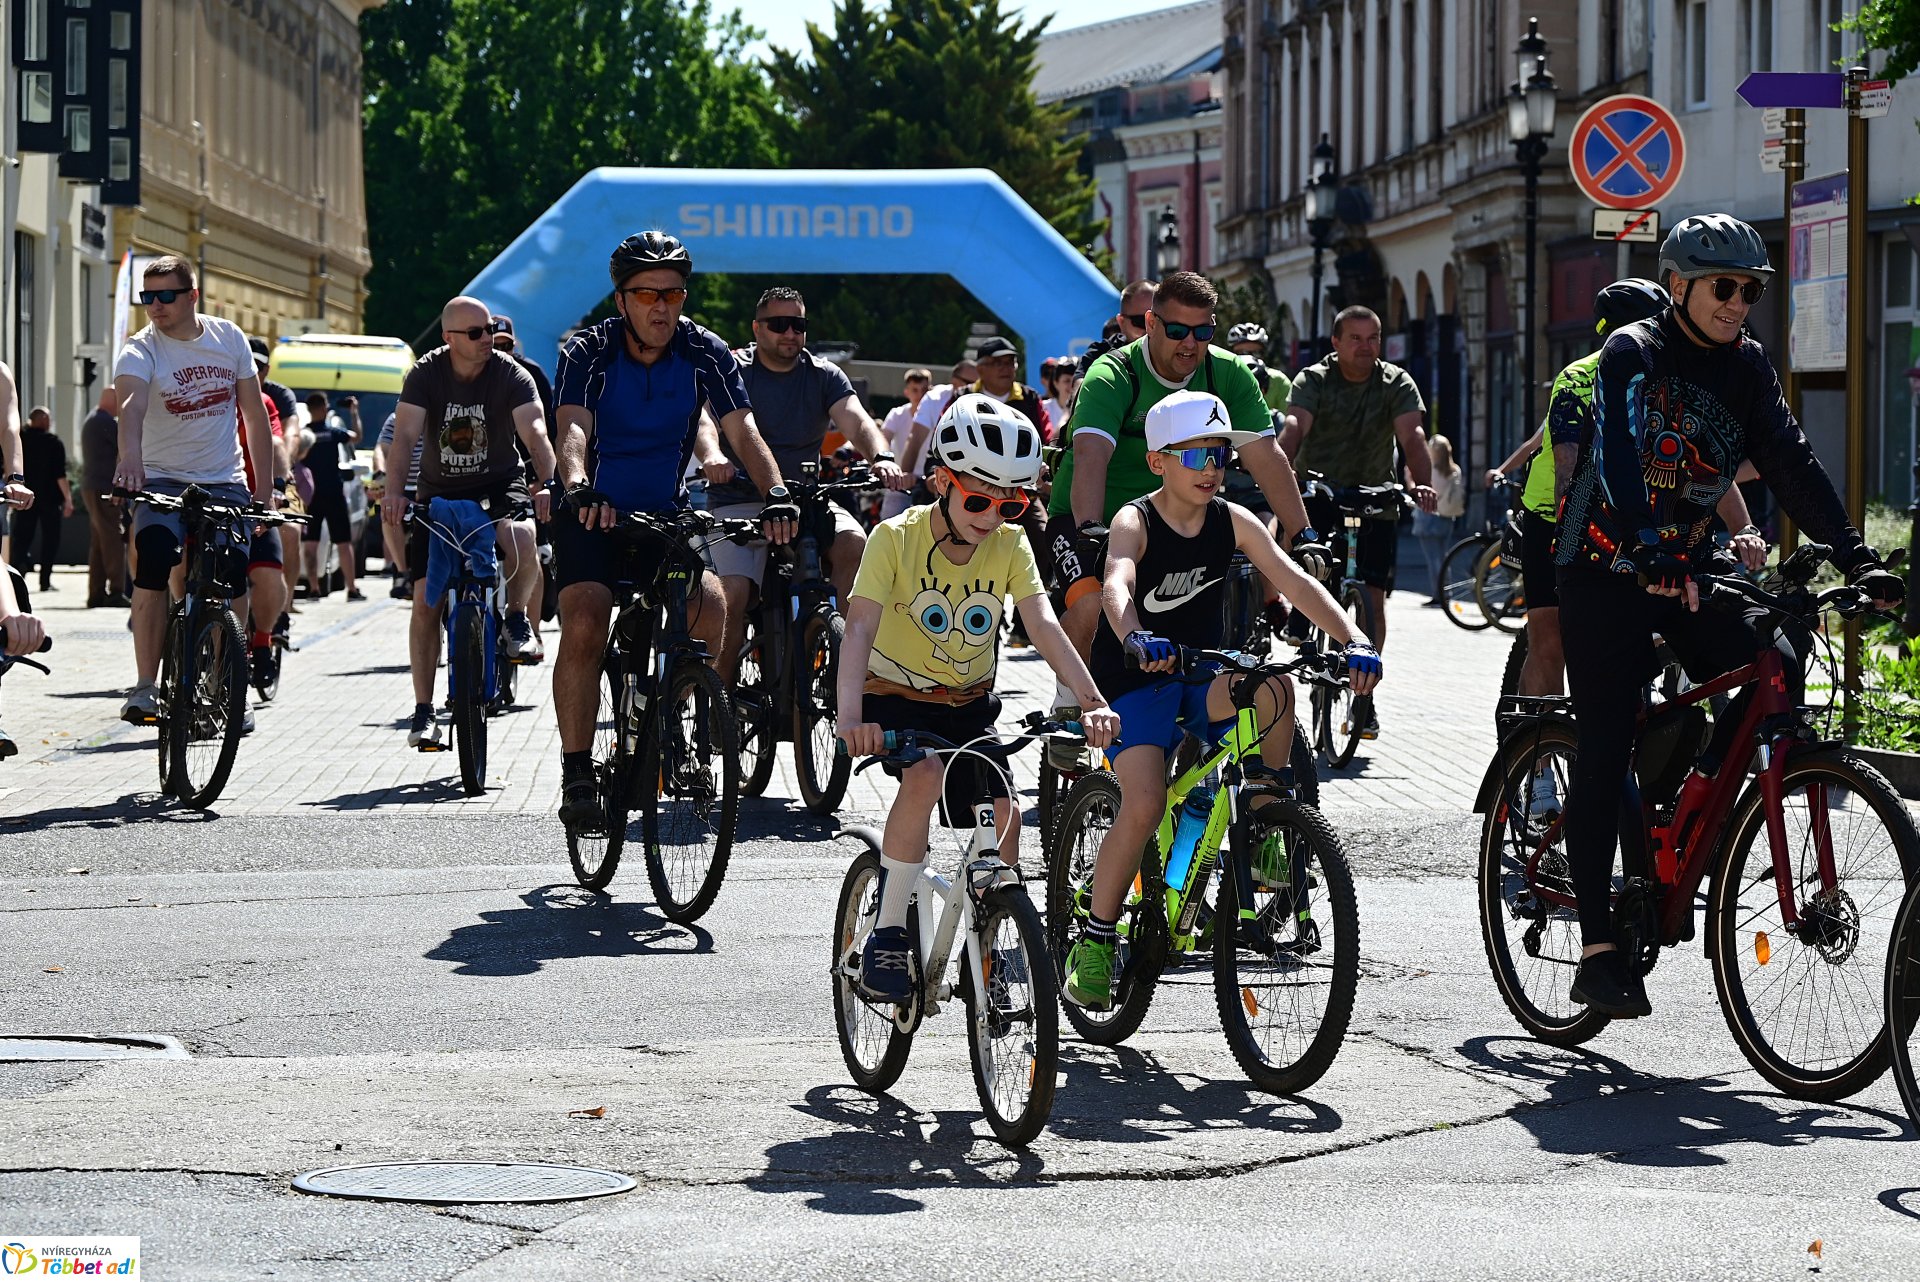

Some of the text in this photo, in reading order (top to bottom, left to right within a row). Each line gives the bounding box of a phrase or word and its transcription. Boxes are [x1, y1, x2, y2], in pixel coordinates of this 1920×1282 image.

[679, 203, 914, 238] SHIMANO
[173, 366, 208, 386] SUPER
[181, 412, 205, 421] CUSTOM
[440, 451, 488, 466] PUFFIN
[1052, 534, 1082, 582] BEMER
[1156, 566, 1207, 596] NIKE
